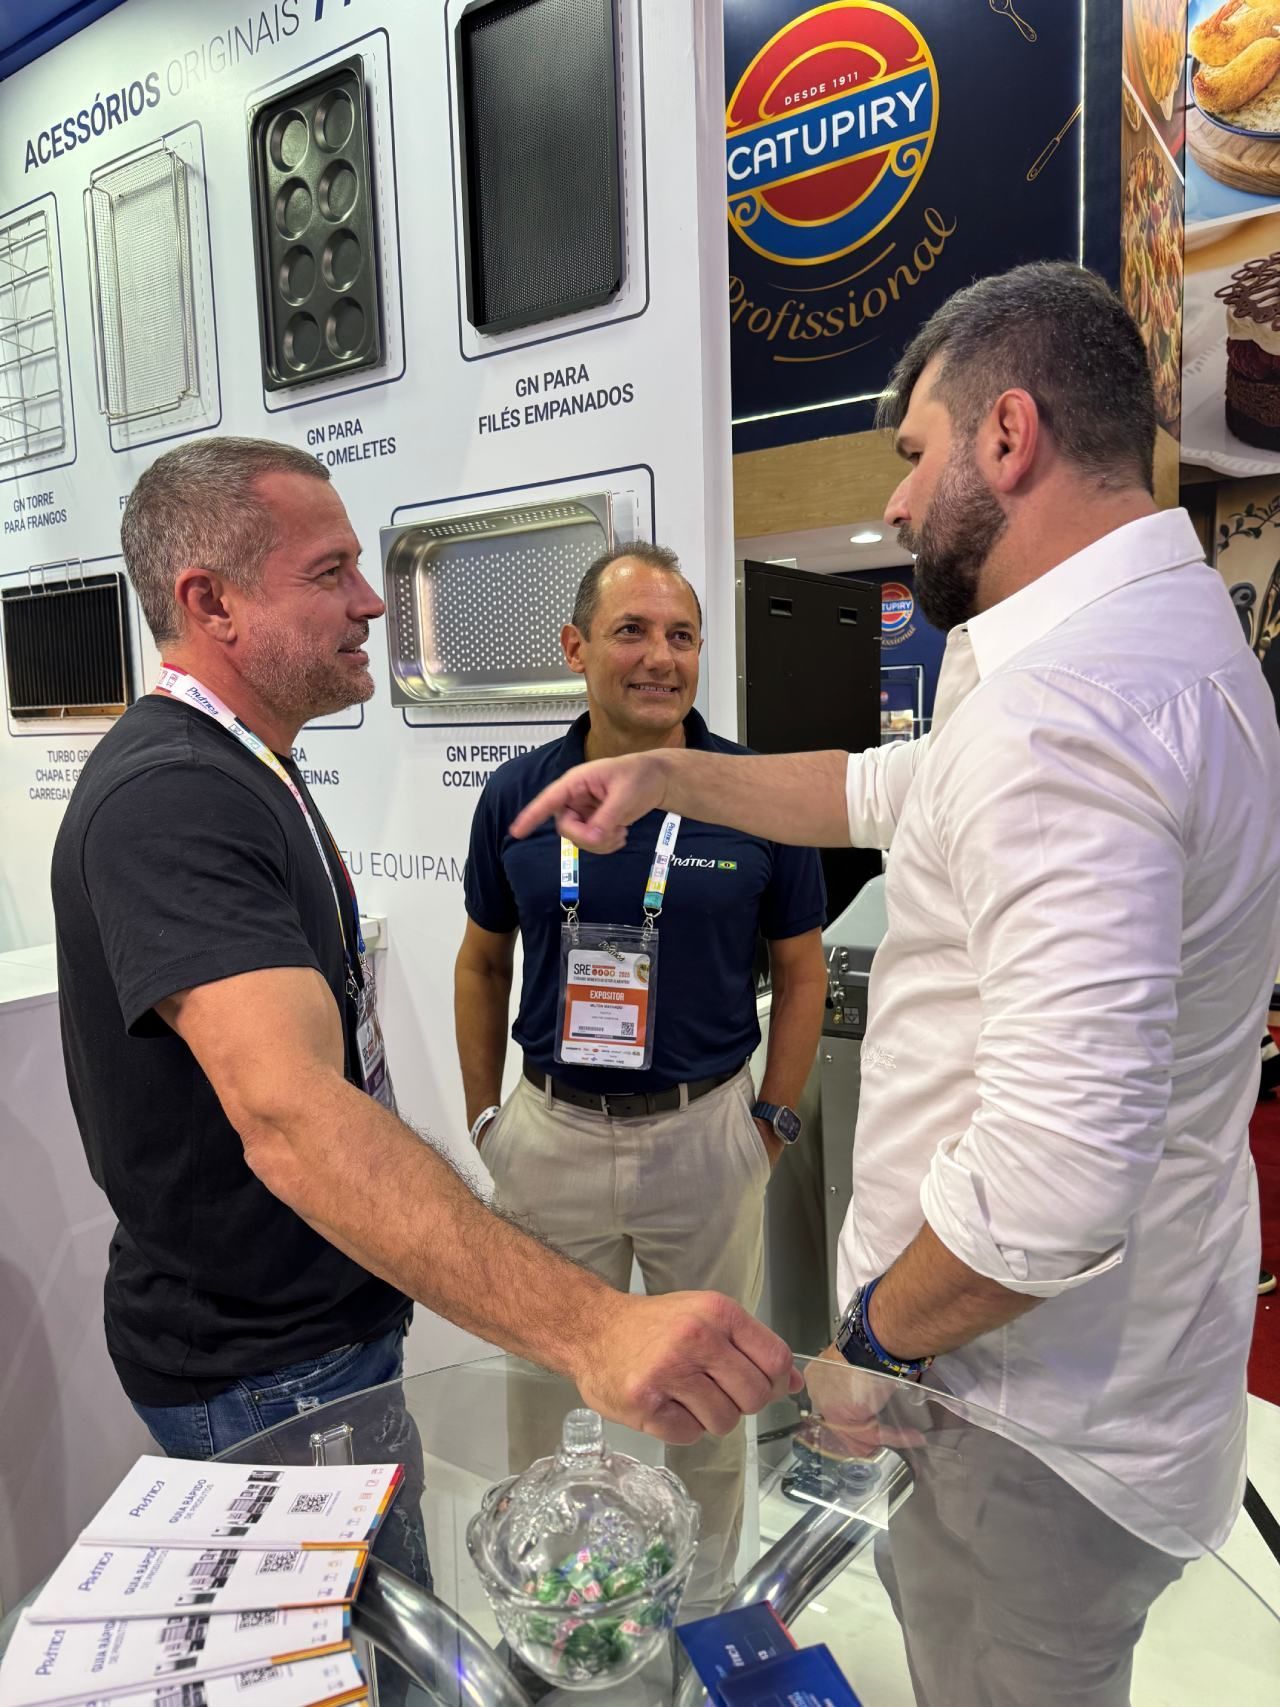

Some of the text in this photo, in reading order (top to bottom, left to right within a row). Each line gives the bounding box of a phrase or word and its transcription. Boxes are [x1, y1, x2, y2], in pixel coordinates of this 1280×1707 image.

[24, 0, 300, 174] ACESSÓRIOS ORIGINAIS
[784, 71, 859, 106] DESDE 1911
[727, 82, 927, 181] CATUPIRY
[729, 207, 957, 341] Profissional
[515, 363, 589, 398] GN PARA
[478, 382, 634, 435] FILÉS EMPANADOS
[307, 418, 363, 446] GN PARA
[326, 437, 396, 466] OMELETES
[13, 491, 54, 512] GN TORRE
[4, 508, 67, 534] PARA FRANGOS
[47, 749, 76, 762] TURBO
[291, 747, 308, 761] RA
[446, 745, 467, 762] GN
[36, 768, 64, 782] CHAPA
[65, 769, 71, 782] E
[301, 769, 340, 785] EINAS
[442, 770, 495, 787] COZIM
[573, 963, 591, 976] SRE
[590, 990, 625, 1001] EXPOSITOR
[168, 1479, 207, 1524] GUIA RÁPIDO
